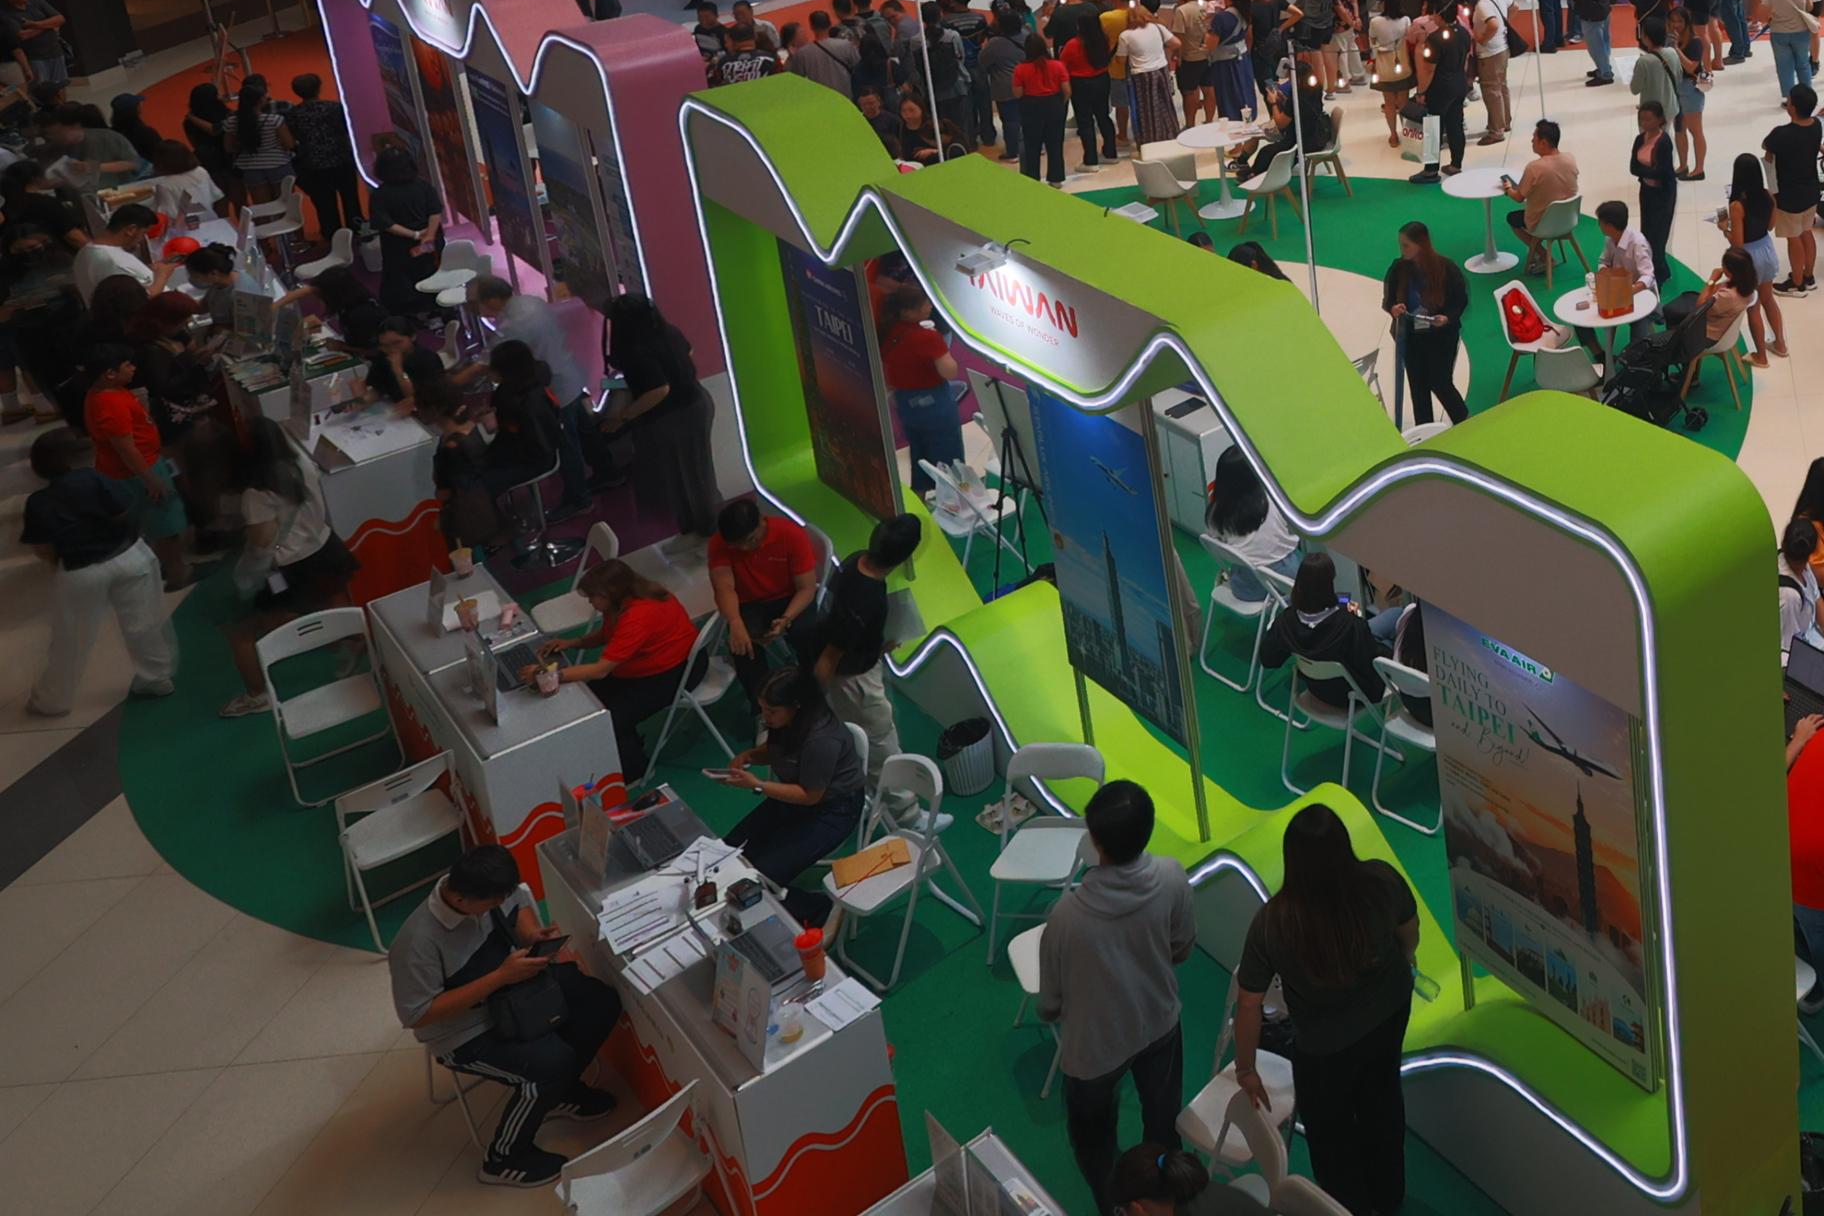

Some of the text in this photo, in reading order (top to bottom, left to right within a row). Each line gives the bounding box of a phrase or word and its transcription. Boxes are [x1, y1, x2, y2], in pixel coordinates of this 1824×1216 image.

[1402, 127, 1424, 140] anko
[1433, 646, 1489, 688] FLYING
[1481, 638, 1510, 663] EVA
[1512, 656, 1537, 675] AIR
[1435, 663, 1481, 700] DAILY
[1486, 692, 1507, 716] TO
[1437, 682, 1517, 745] TAIPEI
